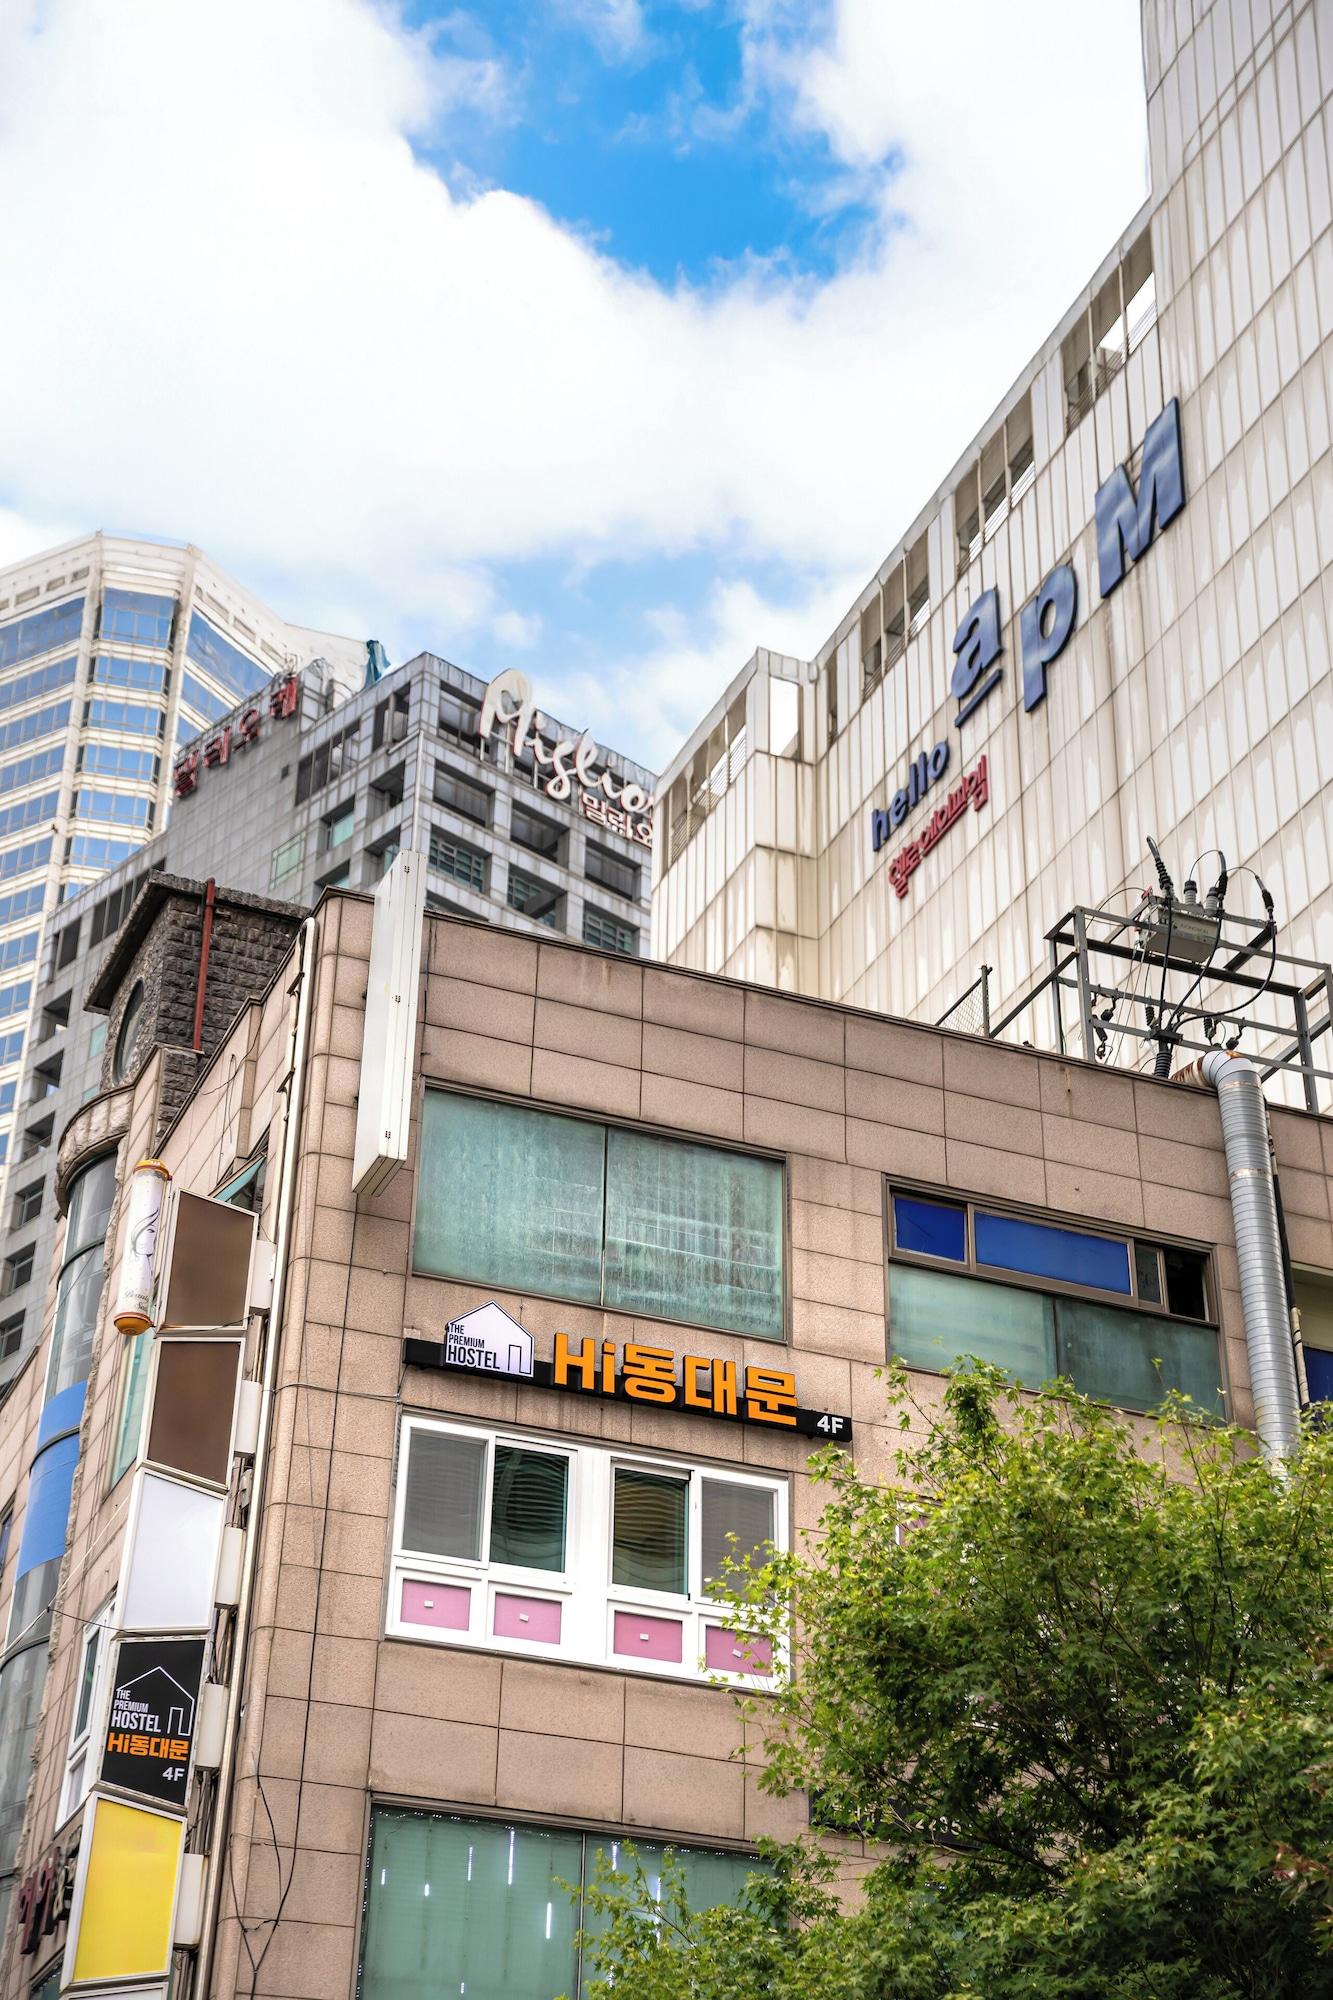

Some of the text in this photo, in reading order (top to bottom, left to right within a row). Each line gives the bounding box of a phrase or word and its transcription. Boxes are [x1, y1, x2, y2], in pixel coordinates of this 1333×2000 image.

[872, 398, 1185, 852] hello apM
[174, 675, 298, 797] 밀리오레
[450, 1323, 465, 1335] THE
[449, 1334, 485, 1349] PREMIUM
[448, 1345, 500, 1370] HOSTEL
[554, 1332, 844, 1434] Hi동대문 4F
[116, 1689, 131, 1700] THE
[114, 1699, 149, 1713] PREMIUM
[111, 1710, 161, 1732] HOSTEL
[107, 1732, 189, 1761] Hi동대문
[163, 1767, 185, 1781] 4F
